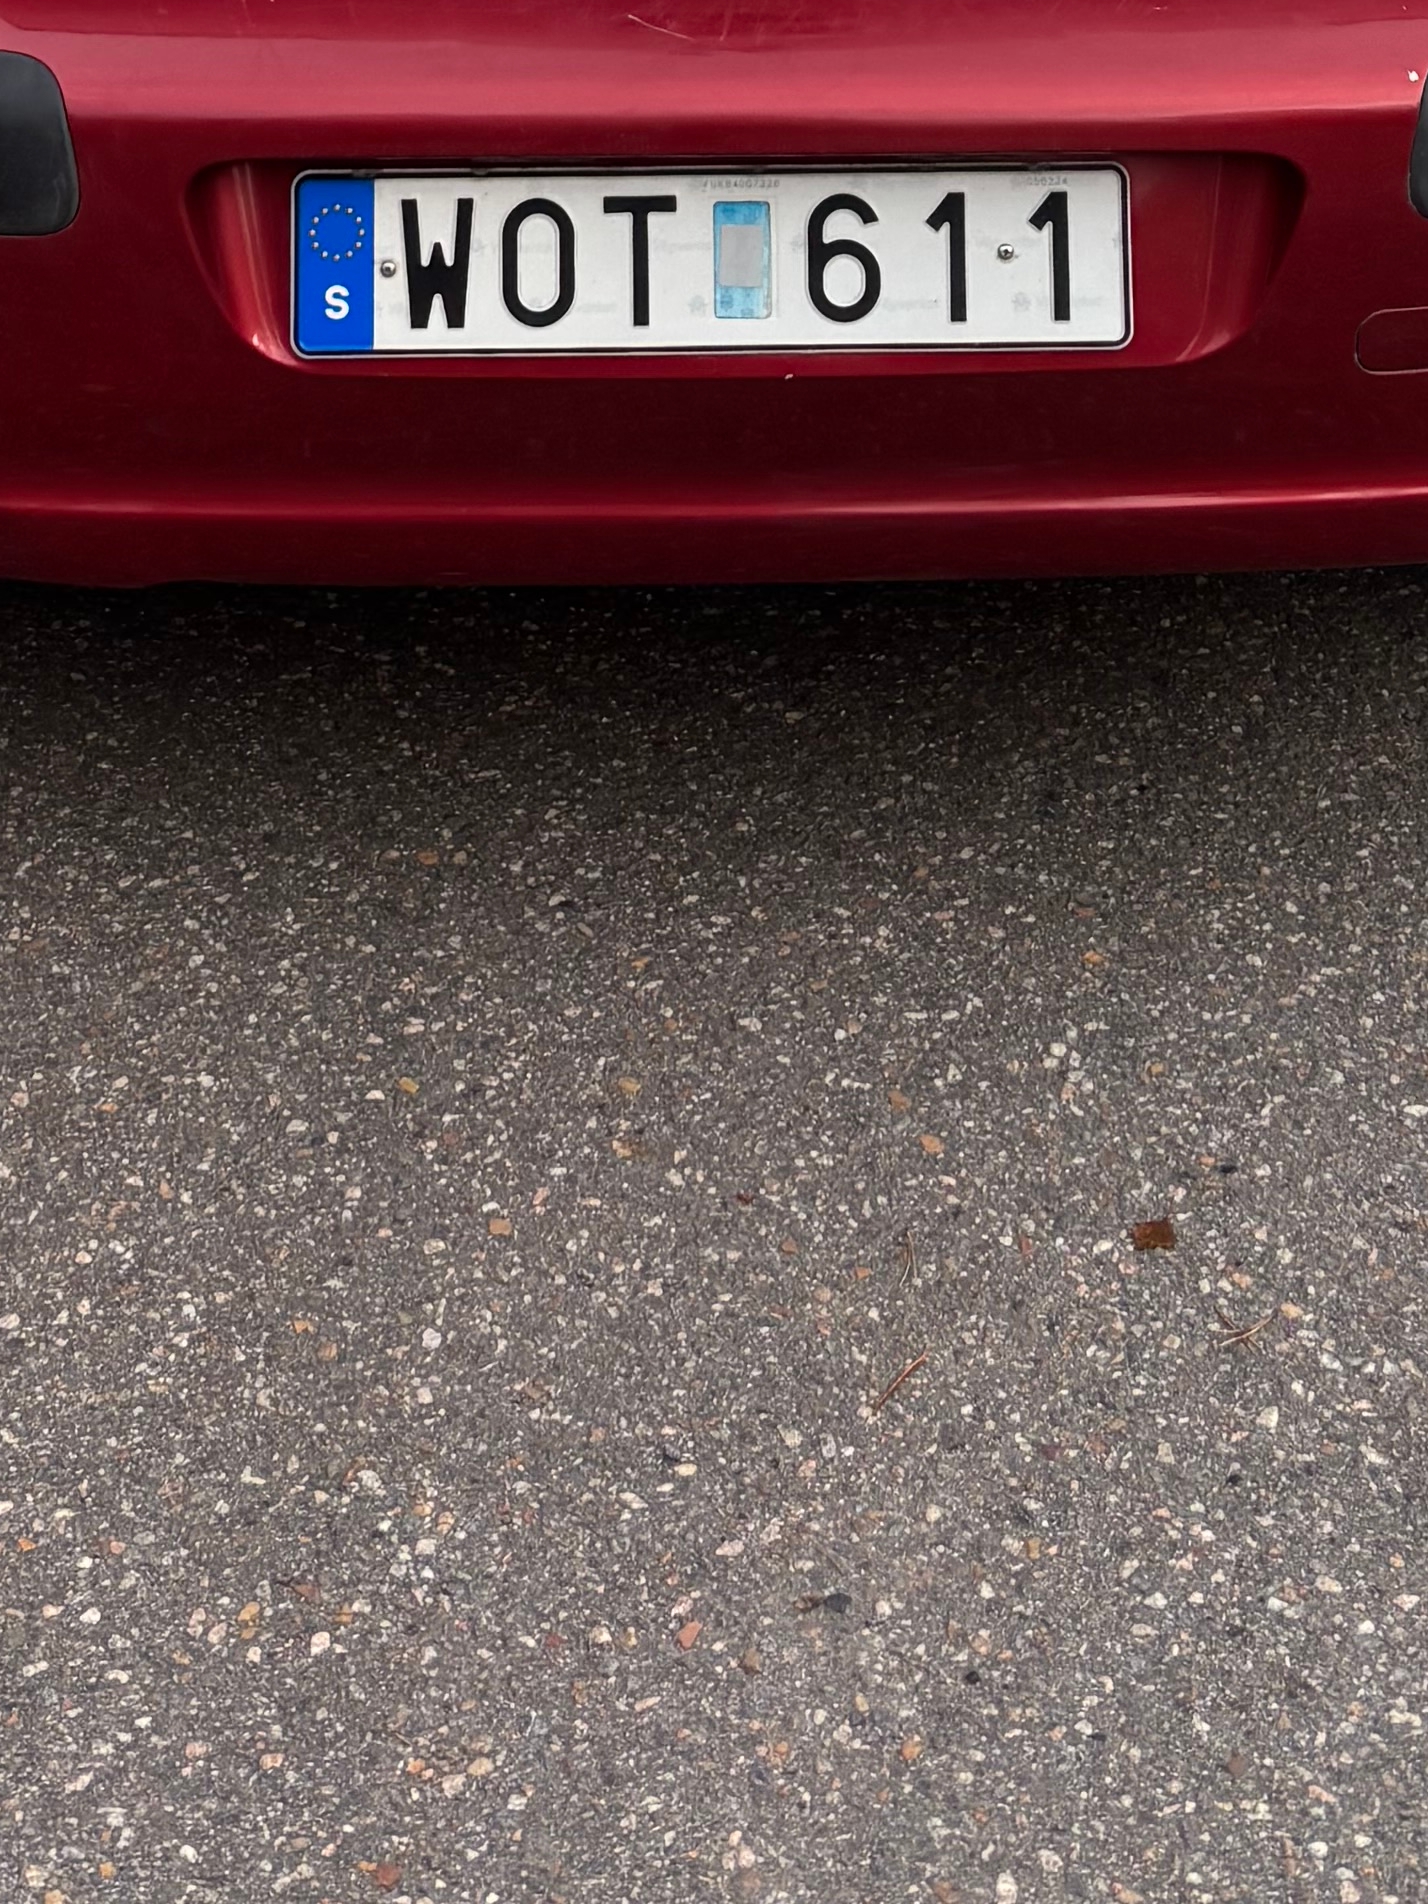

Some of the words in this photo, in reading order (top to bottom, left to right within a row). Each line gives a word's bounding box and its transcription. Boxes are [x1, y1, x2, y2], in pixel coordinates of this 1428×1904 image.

[324, 284, 350, 320] S
[400, 193, 678, 330] WOT
[807, 190, 1069, 324] 611
